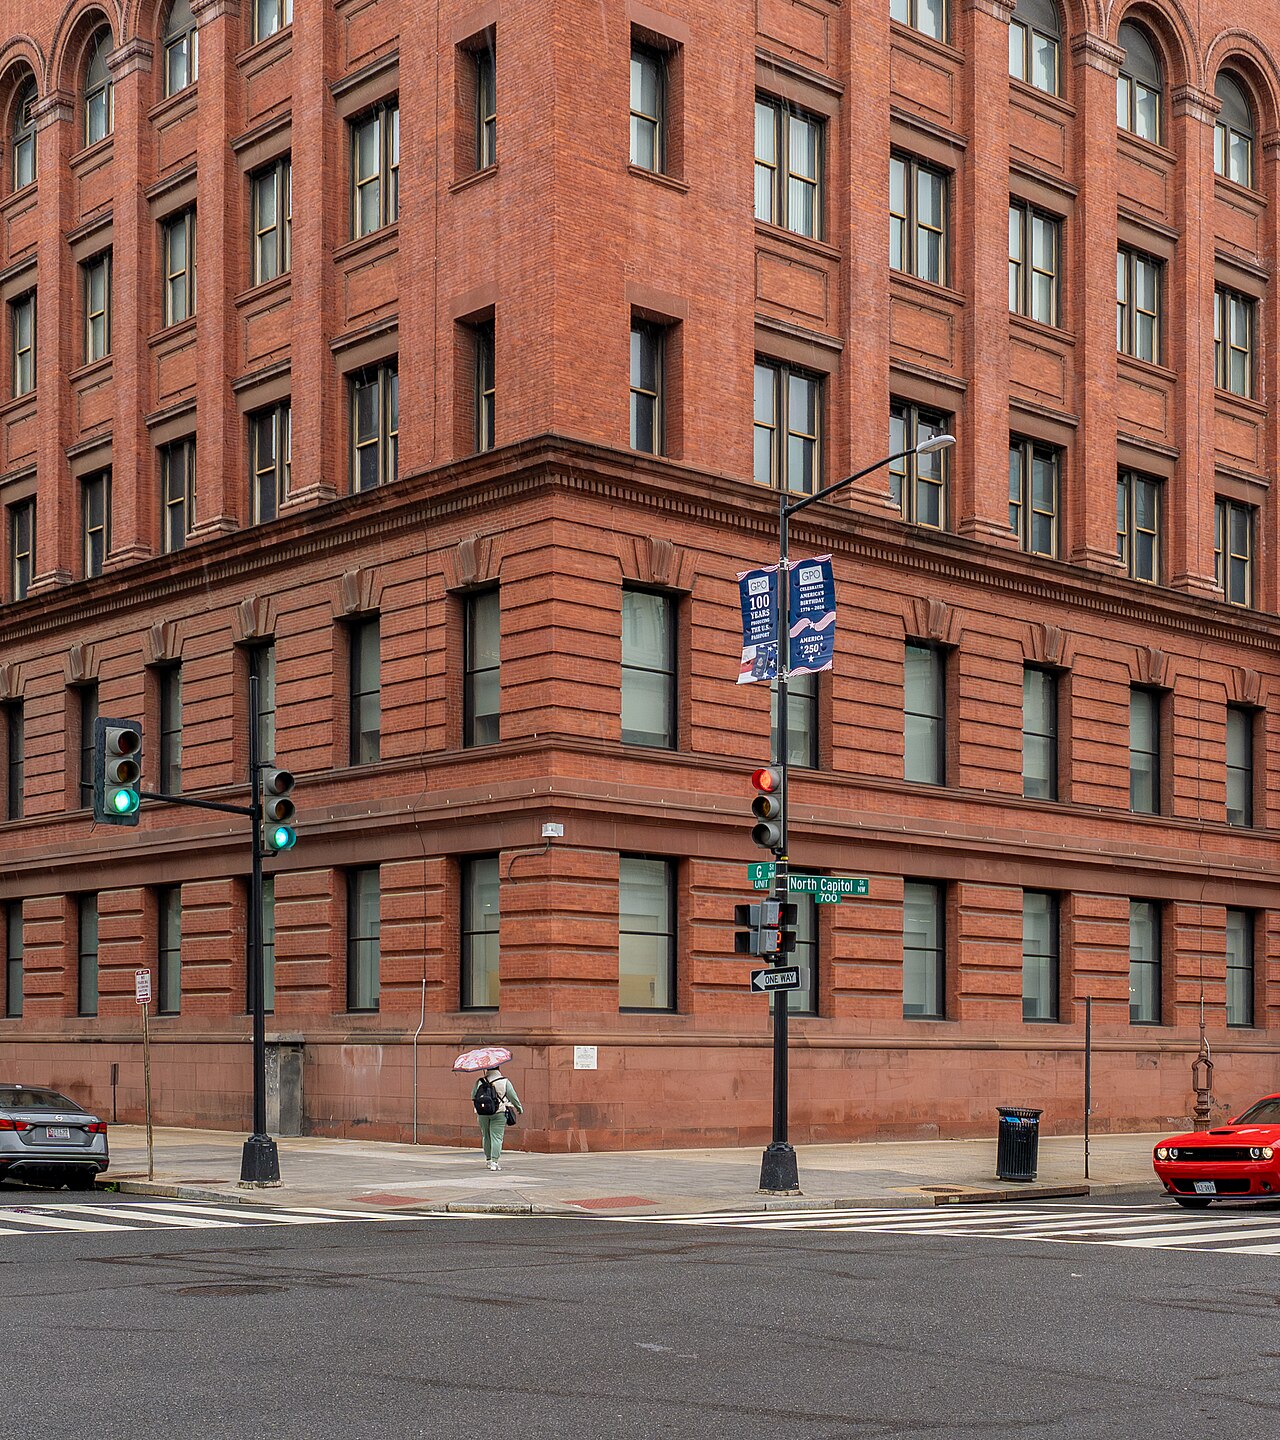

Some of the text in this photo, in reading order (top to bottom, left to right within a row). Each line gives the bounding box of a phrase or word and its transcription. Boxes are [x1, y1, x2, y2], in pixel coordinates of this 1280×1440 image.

[801, 570, 820, 581] GPO
[750, 580, 767, 592] GPO
[800, 584, 824, 592] CELEBRATES
[750, 594, 770, 610] 100
[800, 598, 824, 606] BIRTHDAY
[750, 609, 770, 619] YEARS
[751, 624, 770, 634] THE U.S.
[800, 635, 824, 643] AMERICA
[804, 644, 819, 654] 250
[756, 866, 762, 878] G
[755, 880, 768, 888] UNIT
[790, 878, 853, 893] North Capitol
[820, 894, 838, 902] 700
[765, 973, 795, 984] ONE WAY
